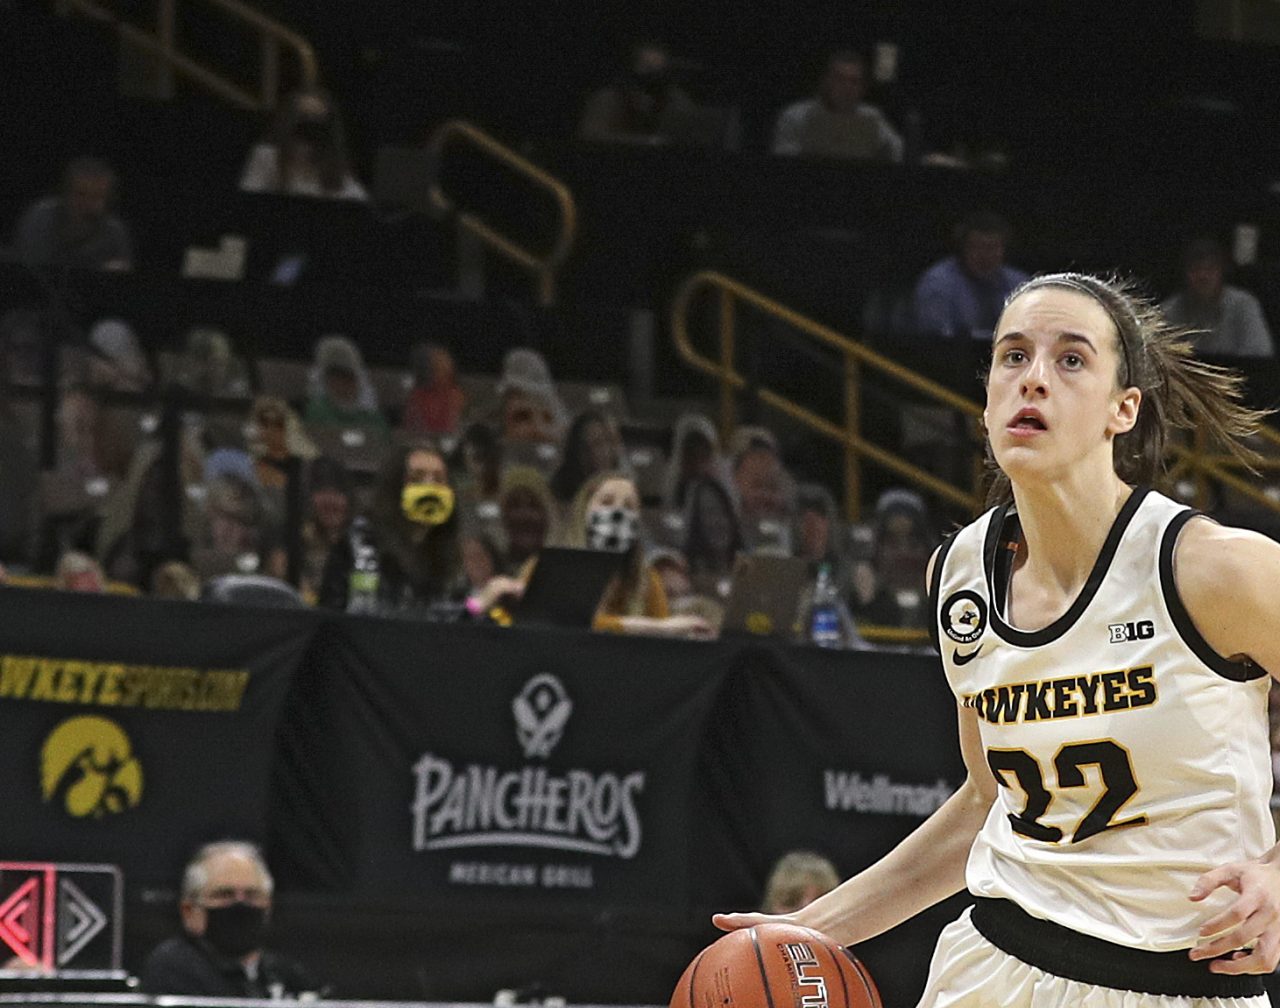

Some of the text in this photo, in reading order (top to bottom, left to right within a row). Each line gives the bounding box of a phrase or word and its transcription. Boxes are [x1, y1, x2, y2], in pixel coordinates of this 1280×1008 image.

[962, 663, 1160, 727] WKEYES
[411, 752, 646, 859] PANCHEROS
[985, 737, 1150, 845] 22
